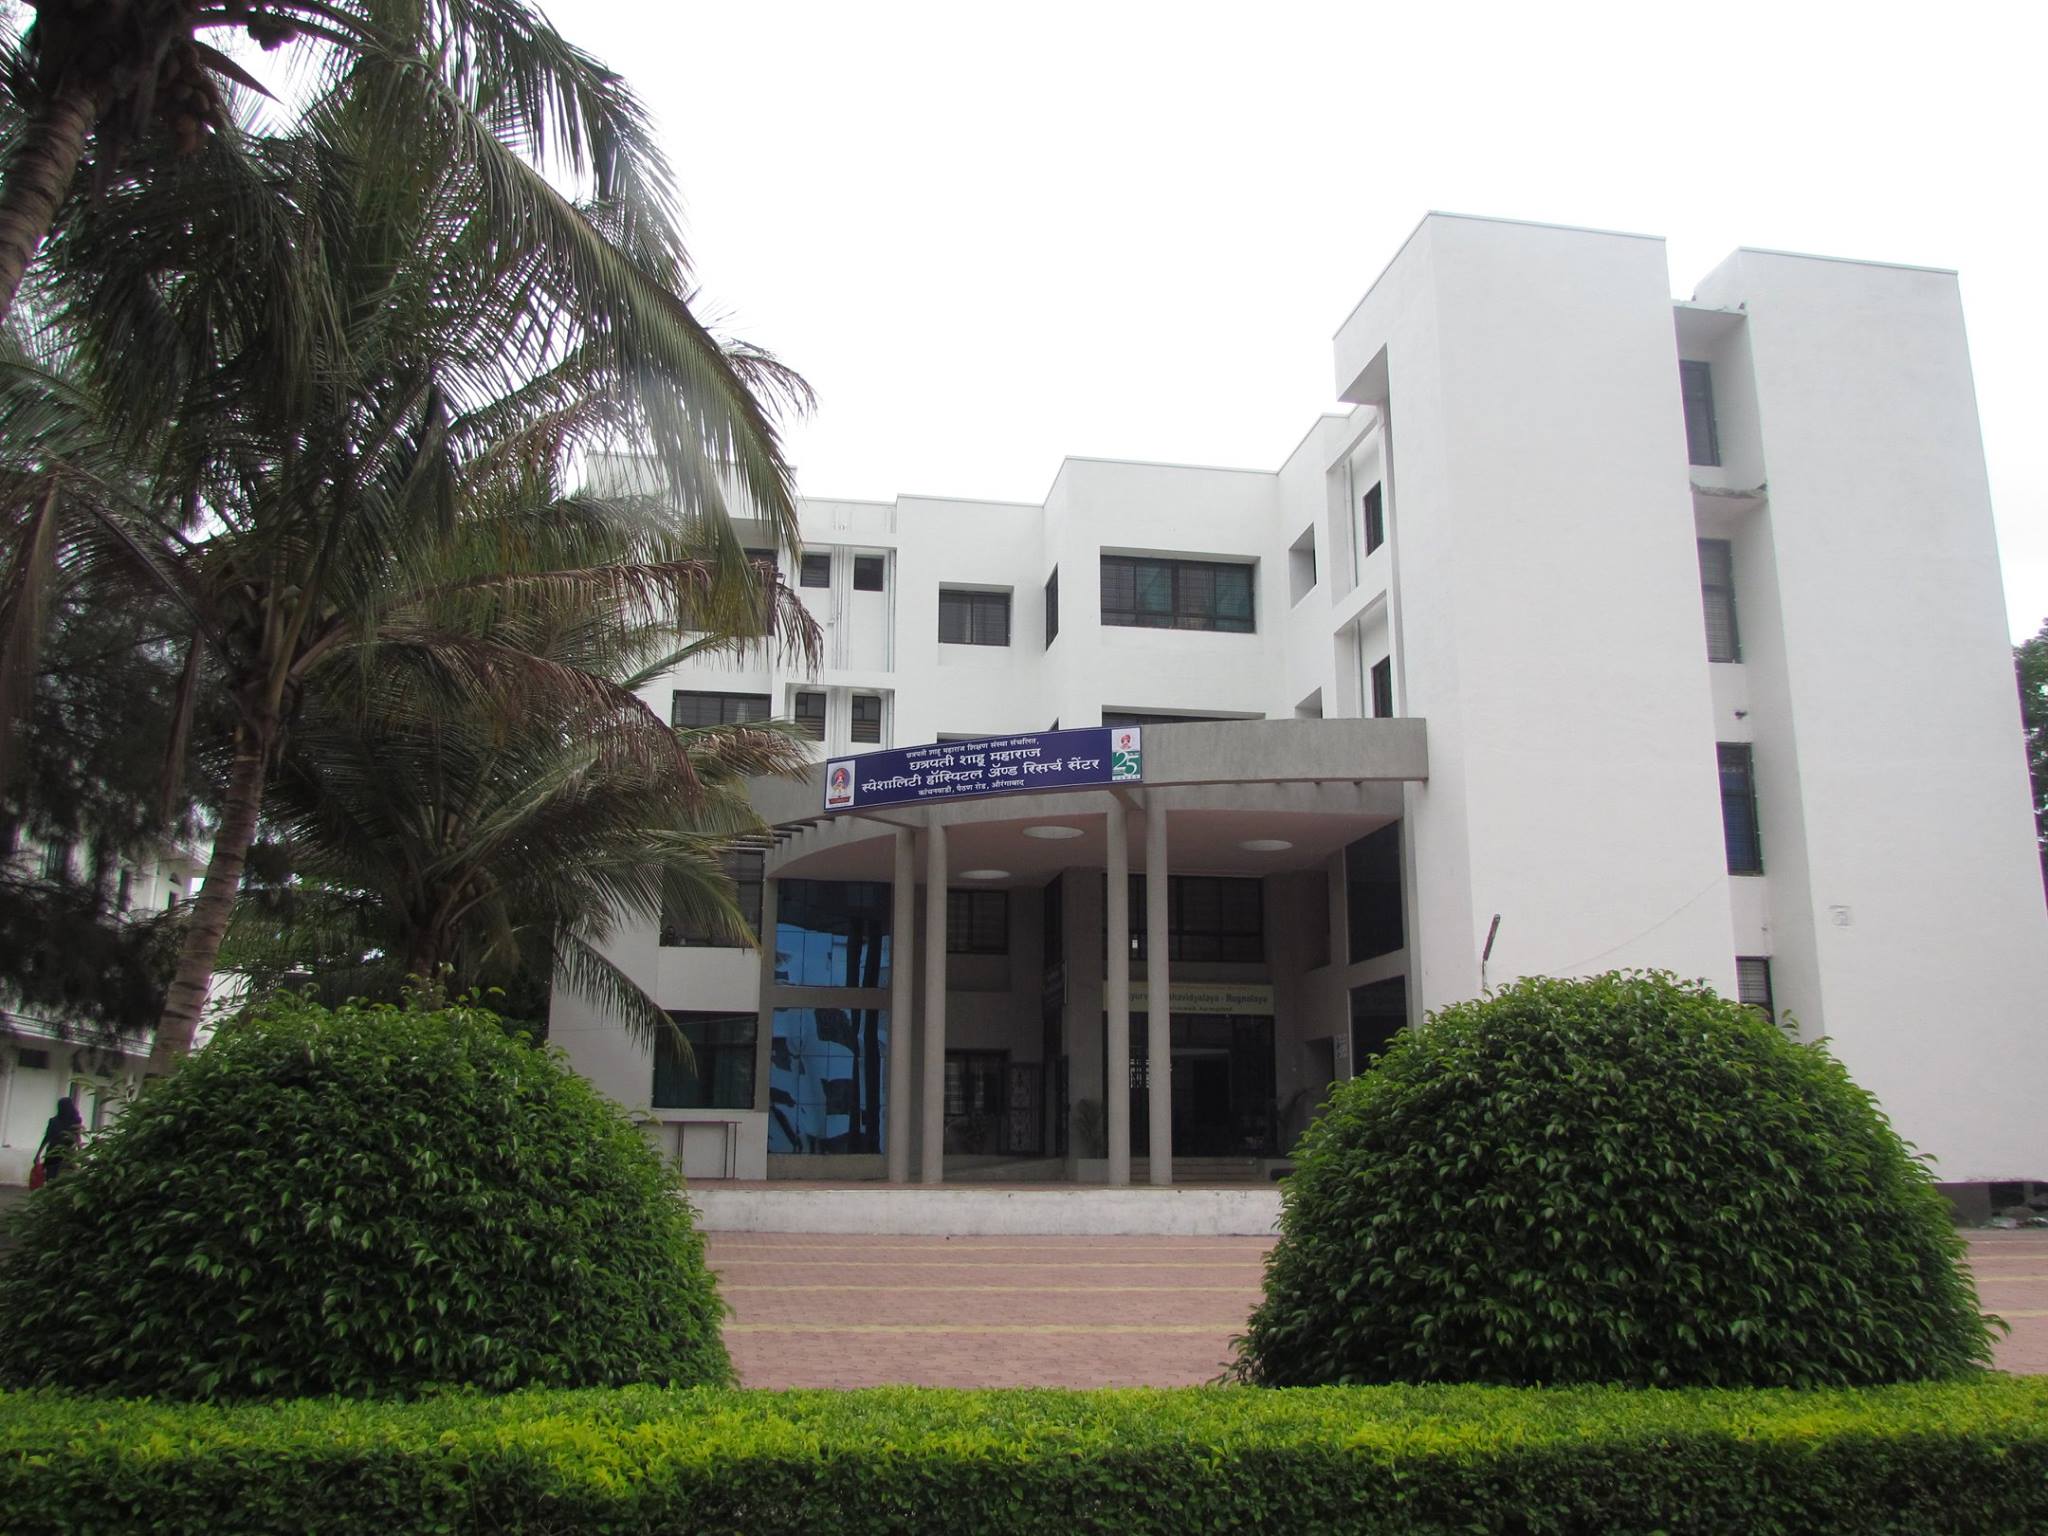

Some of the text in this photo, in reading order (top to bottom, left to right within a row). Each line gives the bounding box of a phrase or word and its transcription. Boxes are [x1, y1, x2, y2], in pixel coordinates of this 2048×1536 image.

[909, 747, 1041, 771] छत्रपती शाहू महाराज
[943, 745, 965, 754] महाराज
[861, 774, 922, 793] स्पेशालिटी
[926, 769, 983, 786] हॉस्पिटल
[1022, 758, 1063, 775] रिसर्च
[1067, 756, 1101, 771] सेंटर
[1112, 751, 1139, 775] 25
